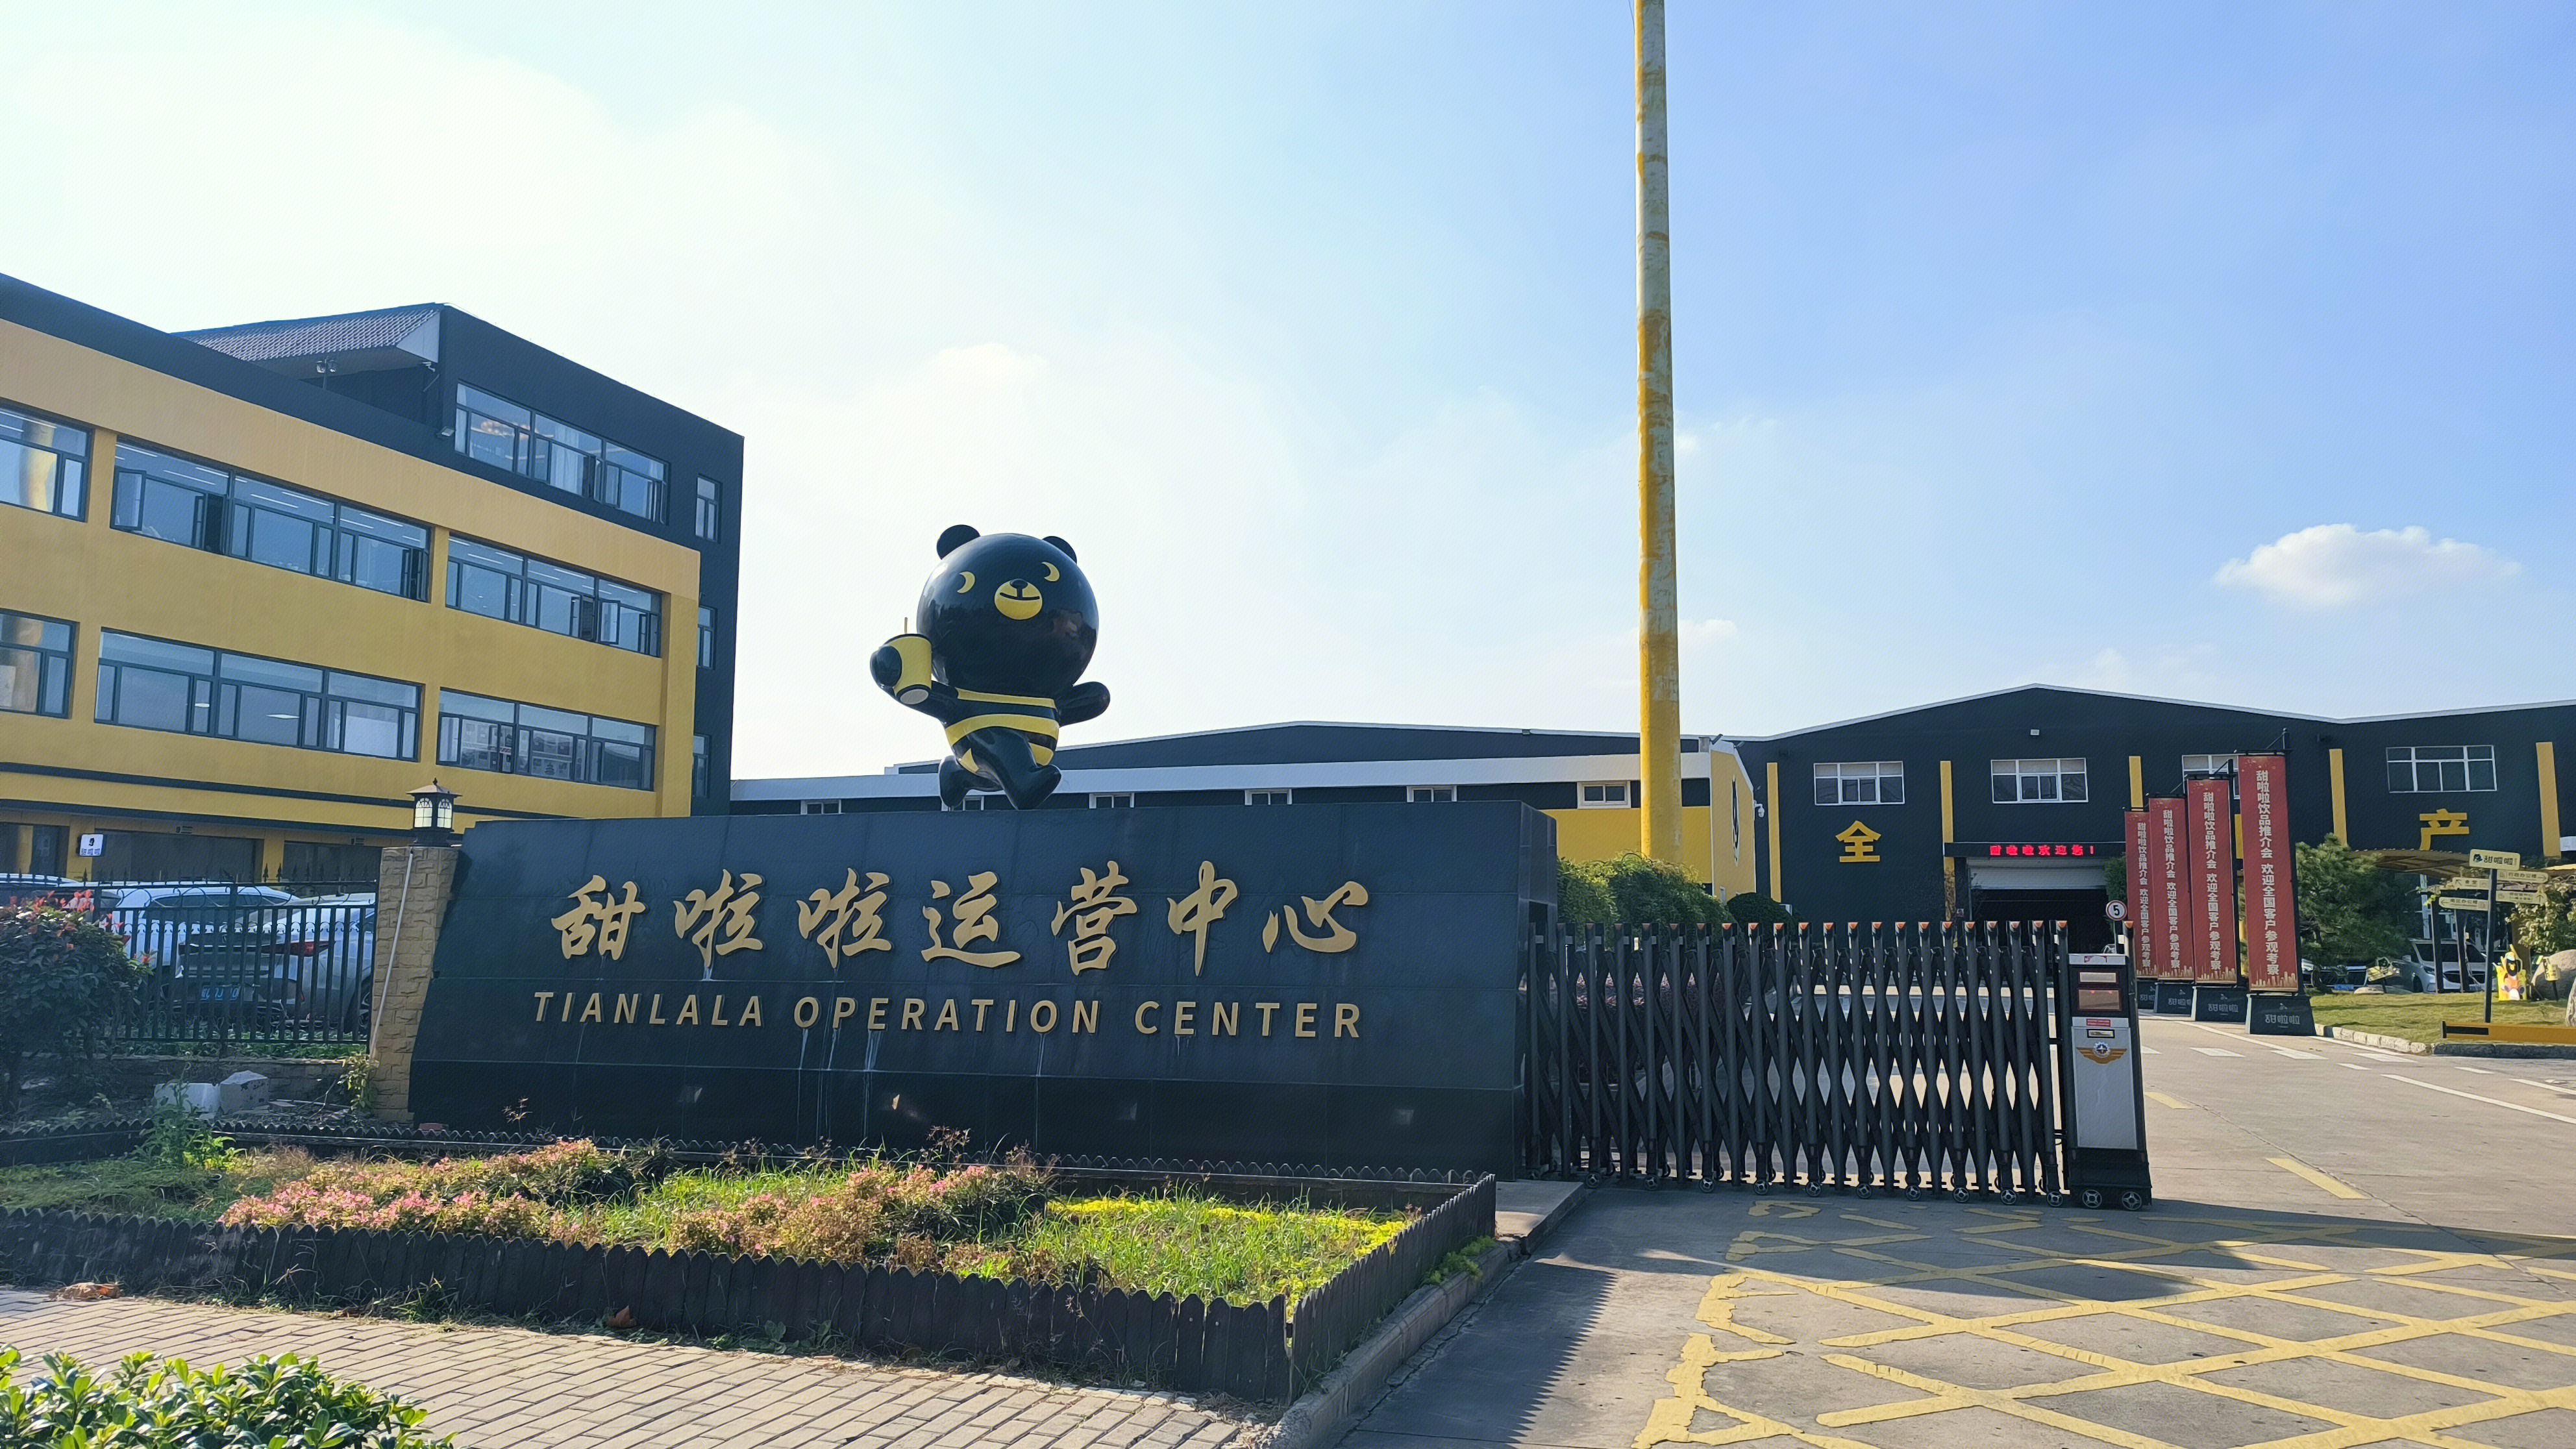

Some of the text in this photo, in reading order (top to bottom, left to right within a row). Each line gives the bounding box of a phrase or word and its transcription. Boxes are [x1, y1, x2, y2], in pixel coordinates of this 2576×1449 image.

[2255, 769, 2273, 860] 甜啦啦饮品推介会
[2419, 808, 2470, 850] 产
[1835, 821, 1881, 863] 全
[551, 860, 1371, 976] 甜啦啦运营中心
[2112, 904, 2121, 916] 5
[534, 991, 1362, 1039] TIANLALA OPERATION CENTER
[2264, 1014, 2301, 1025] 甜啦啦
